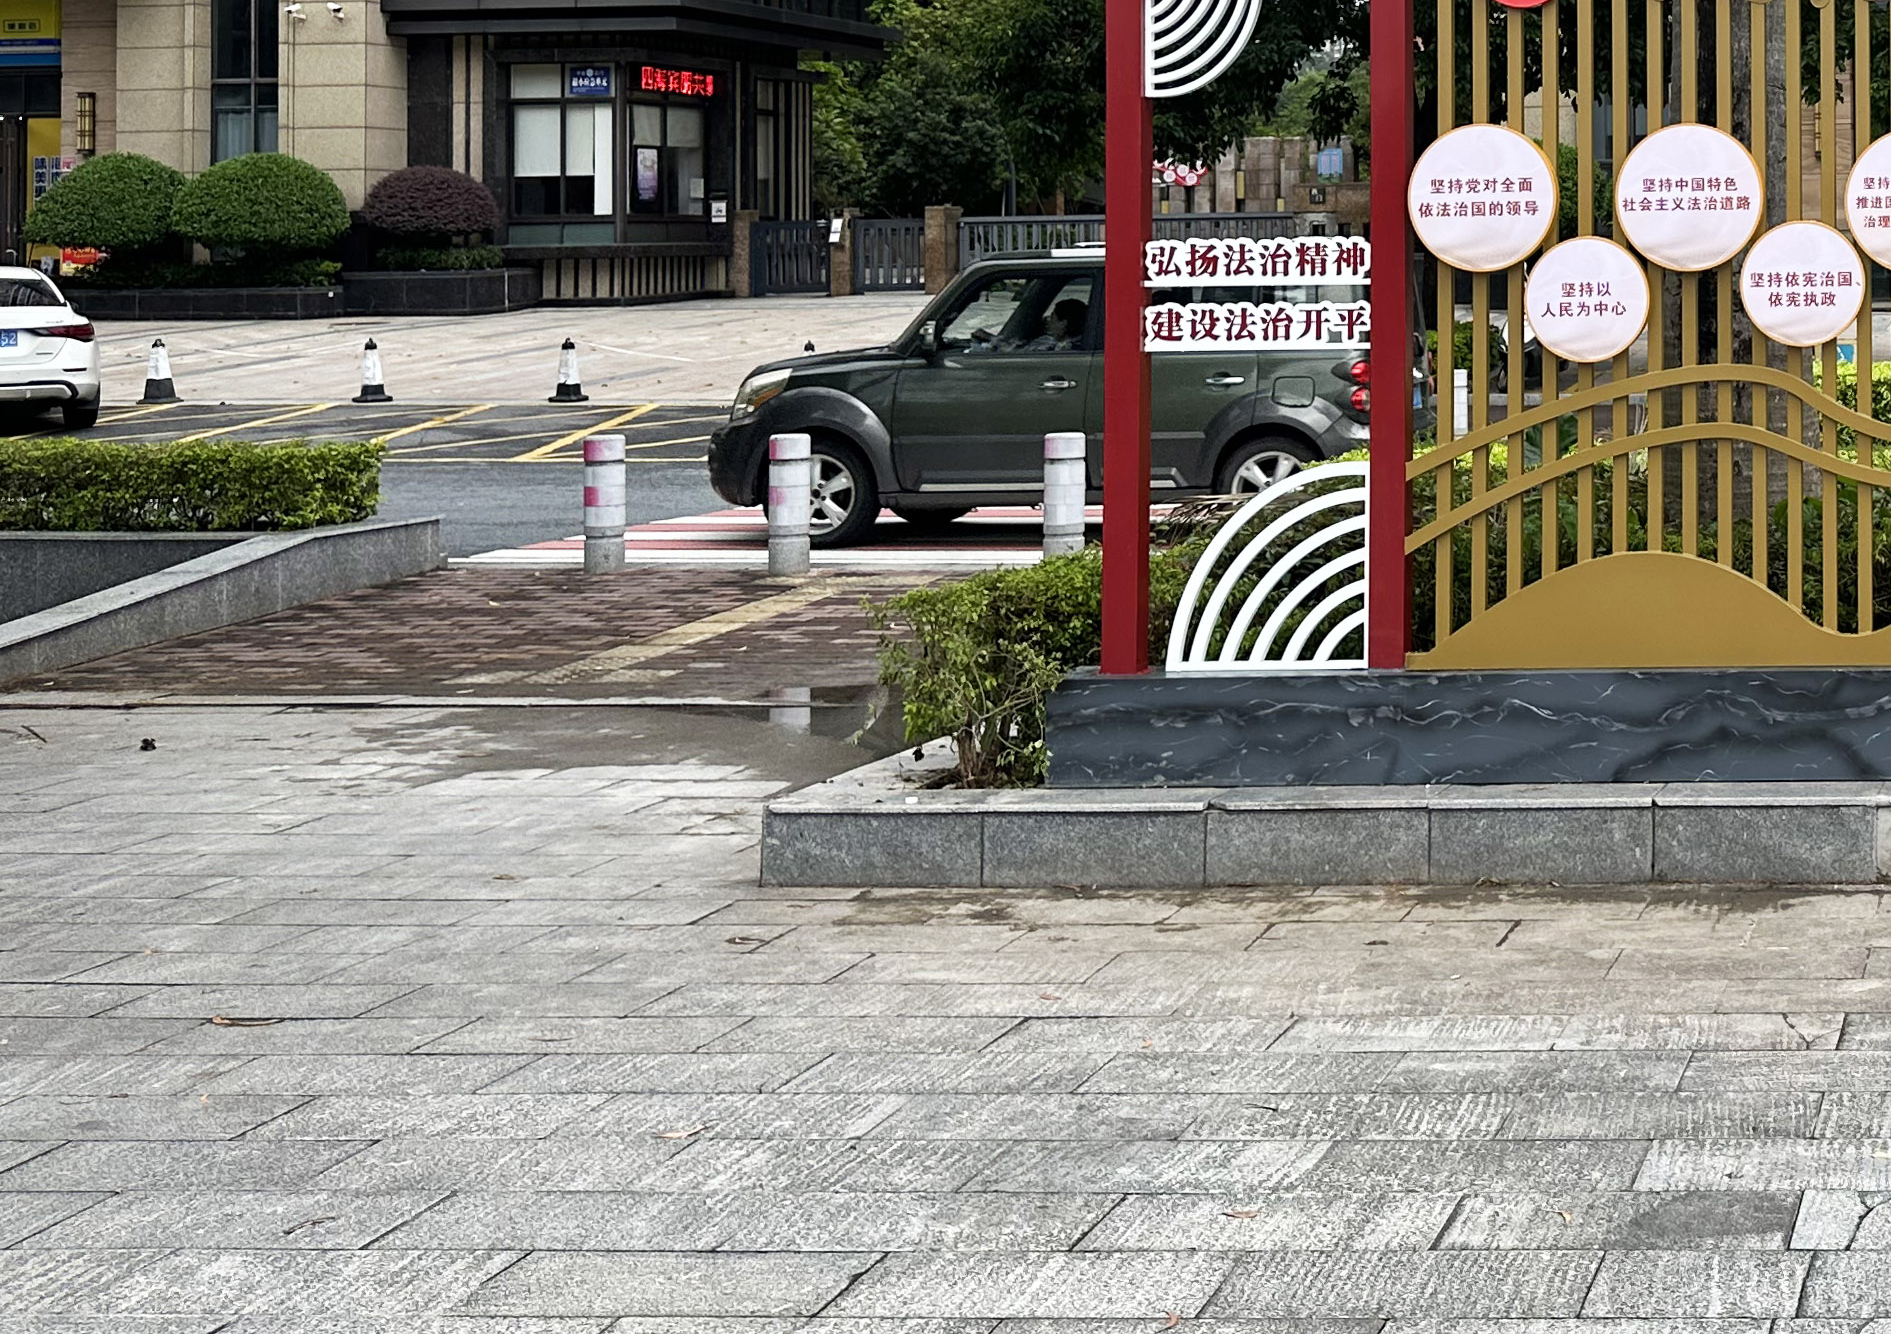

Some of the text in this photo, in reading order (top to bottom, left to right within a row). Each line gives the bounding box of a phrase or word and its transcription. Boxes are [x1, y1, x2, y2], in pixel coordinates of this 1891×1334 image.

[1430, 178, 1532, 194] 坚持党对全面
[1643, 177, 1737, 192] 坚持中国特色
[1418, 201, 1538, 217] 依法治国的领导
[1622, 196, 1750, 211] 社会主义法治道路
[1151, 243, 1366, 277] 弘扬法治精神
[1751, 272, 1860, 287] 坚持依宪治国、
[1562, 282, 1611, 297] 坚持以
[1768, 292, 1836, 307] 依宪执政
[1541, 301, 1626, 317] 人民为中心
[1150, 306, 1367, 342] 建设法治开平
